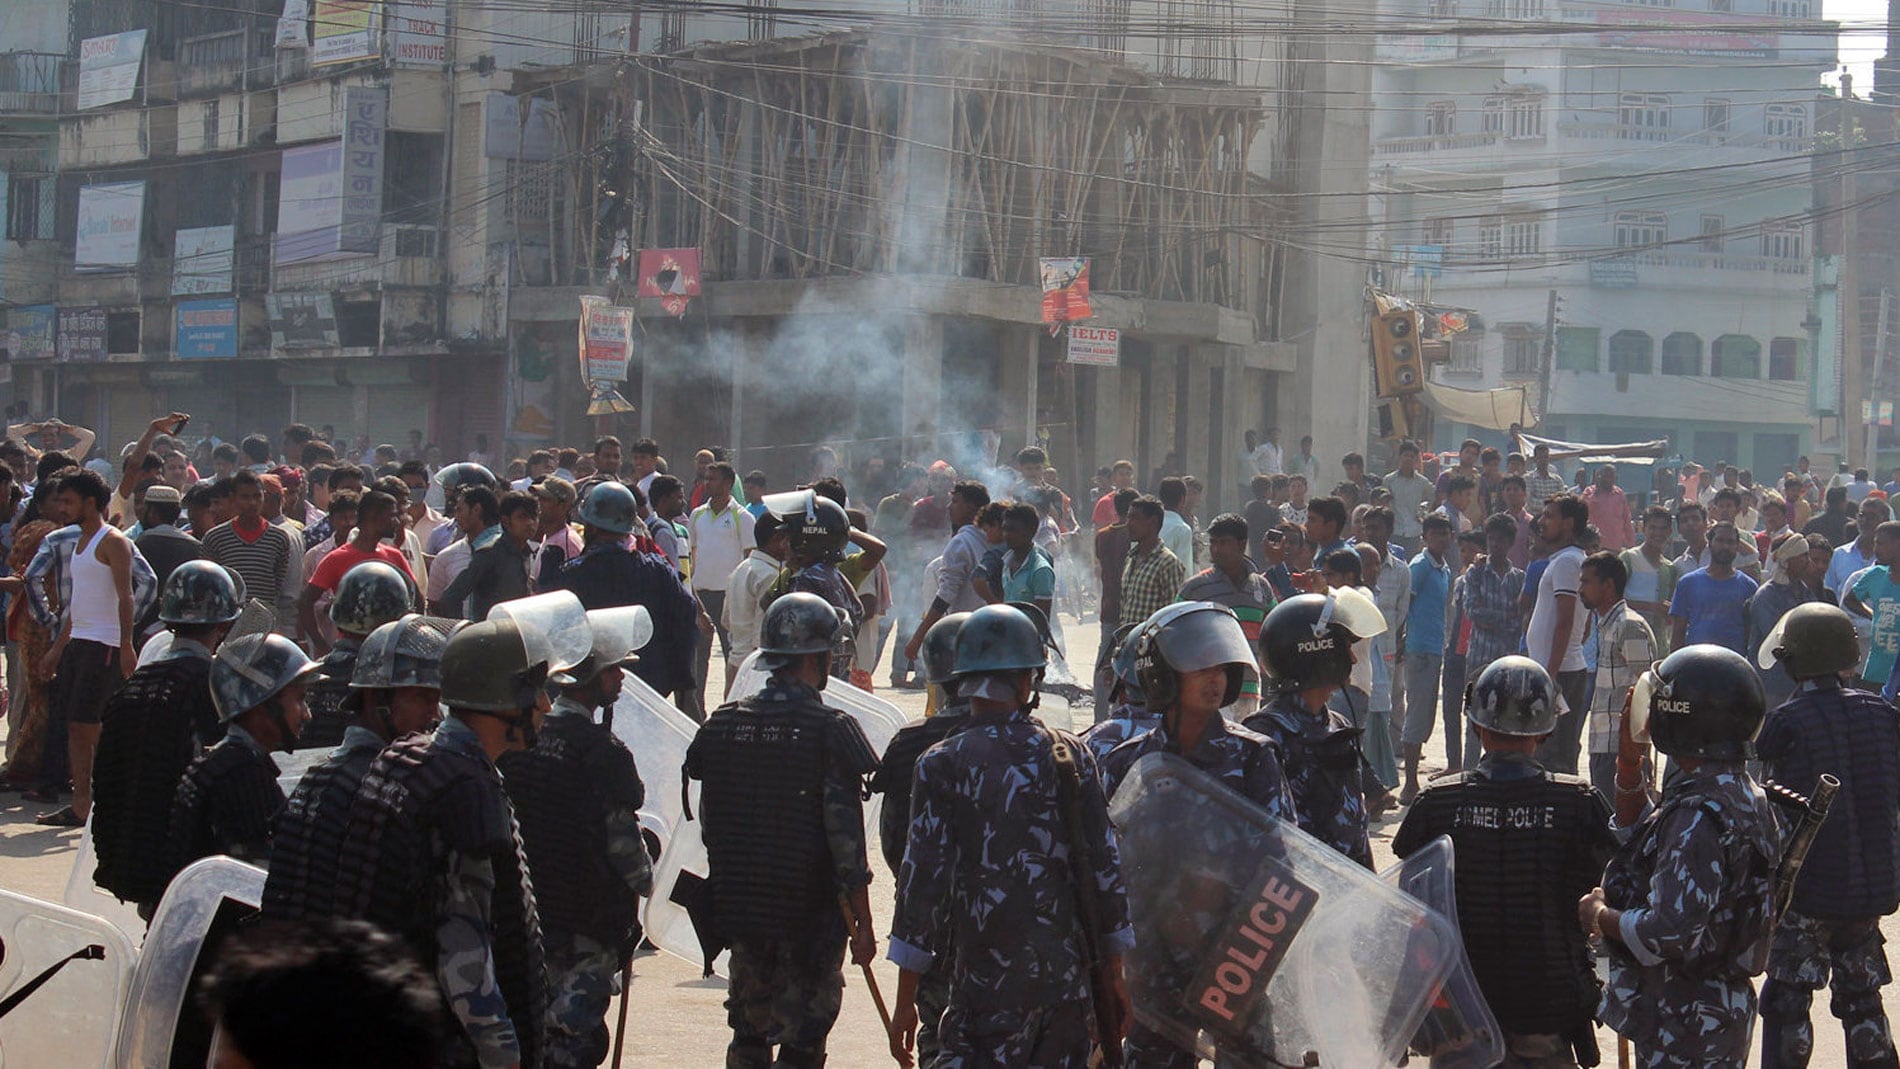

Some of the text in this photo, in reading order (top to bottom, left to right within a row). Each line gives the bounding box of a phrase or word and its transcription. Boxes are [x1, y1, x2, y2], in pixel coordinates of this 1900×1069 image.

[408, 20, 437, 34] TRACK
[399, 43, 446, 61] INSTITUTE
[1072, 327, 1117, 341] IELTS
[802, 526, 828, 535] NEPAL
[1297, 638, 1335, 653] POLICE
[1135, 655, 1154, 671] EPAL
[1657, 699, 1690, 713] POLICE
[1506, 805, 1554, 829] POLIE
[1200, 875, 1304, 1021] POLICE
